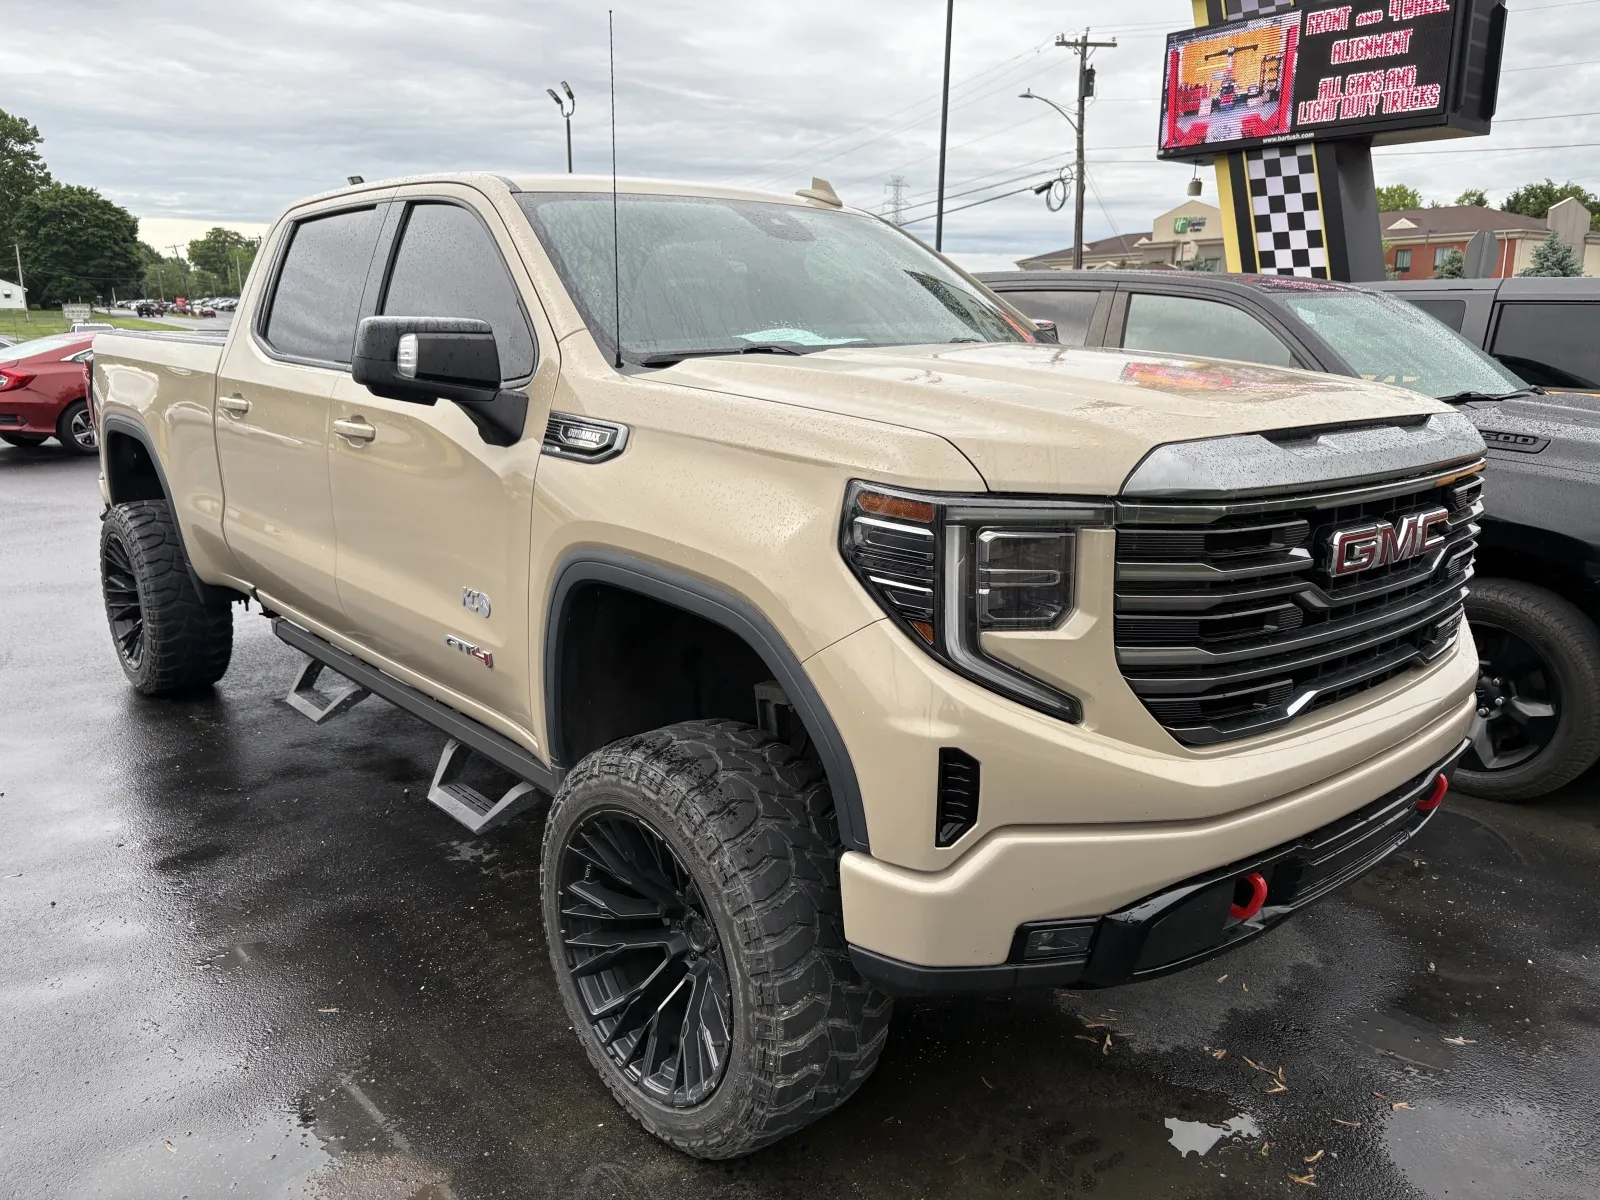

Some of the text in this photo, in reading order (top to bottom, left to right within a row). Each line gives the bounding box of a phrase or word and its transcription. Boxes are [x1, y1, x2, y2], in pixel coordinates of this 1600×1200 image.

[1306, 5, 1352, 36] FRONT
[1330, 28, 1413, 65] ALIGNMENT
[1317, 65, 1416, 102] ALL CARS AND
[1297, 83, 1440, 125] LIGHT DUTY TRUCKS
[1262, 132, 1315, 144] www.bartush.com
[567, 428, 601, 442] DURAMAX
[1331, 508, 1448, 578] GMC
